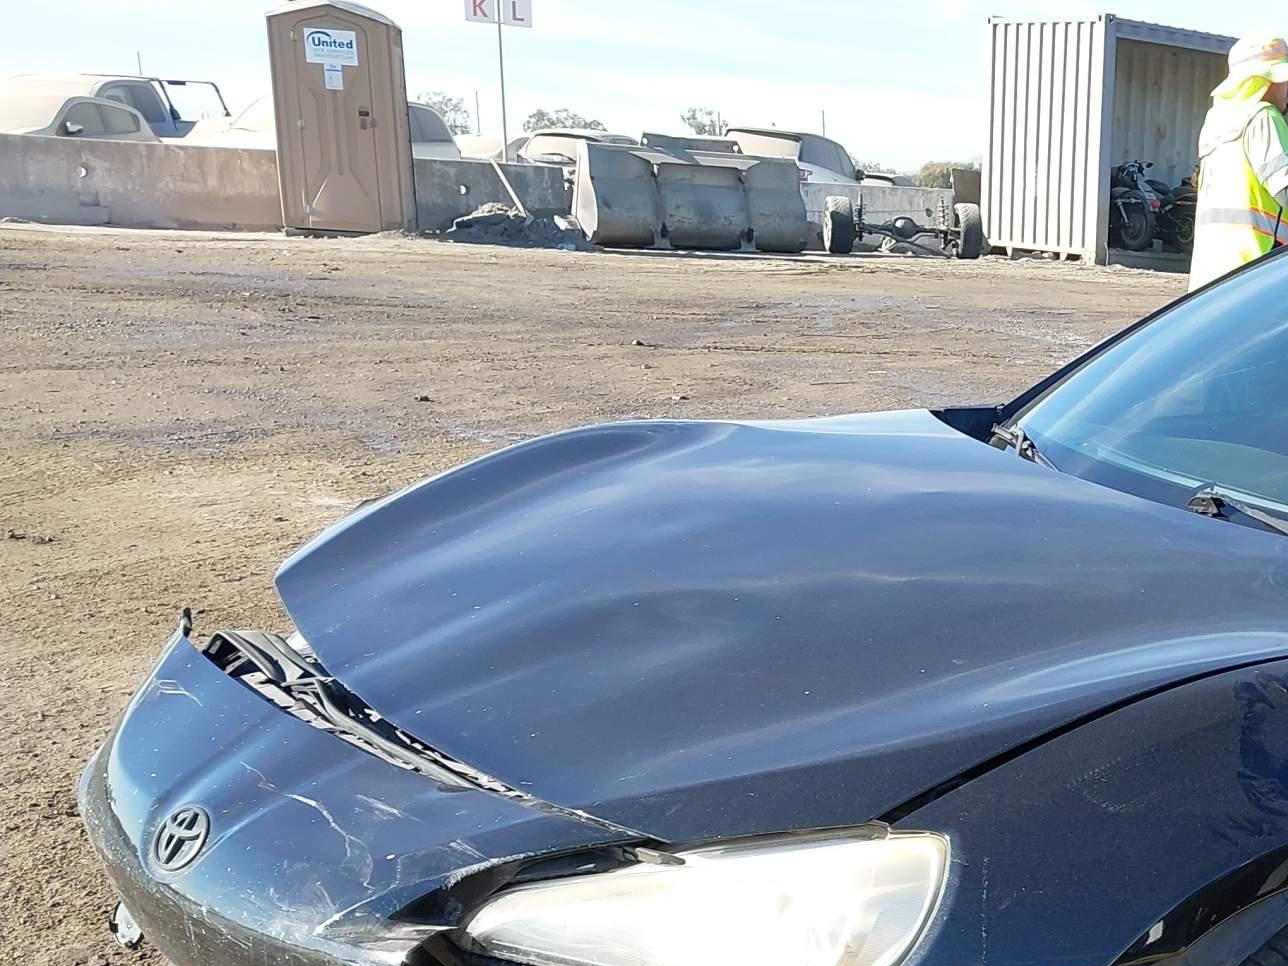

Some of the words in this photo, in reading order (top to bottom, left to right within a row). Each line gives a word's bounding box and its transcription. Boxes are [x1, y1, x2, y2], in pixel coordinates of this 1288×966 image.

[472, 0, 489, 18] K
[511, 1, 525, 22] L
[311, 36, 354, 49] United
